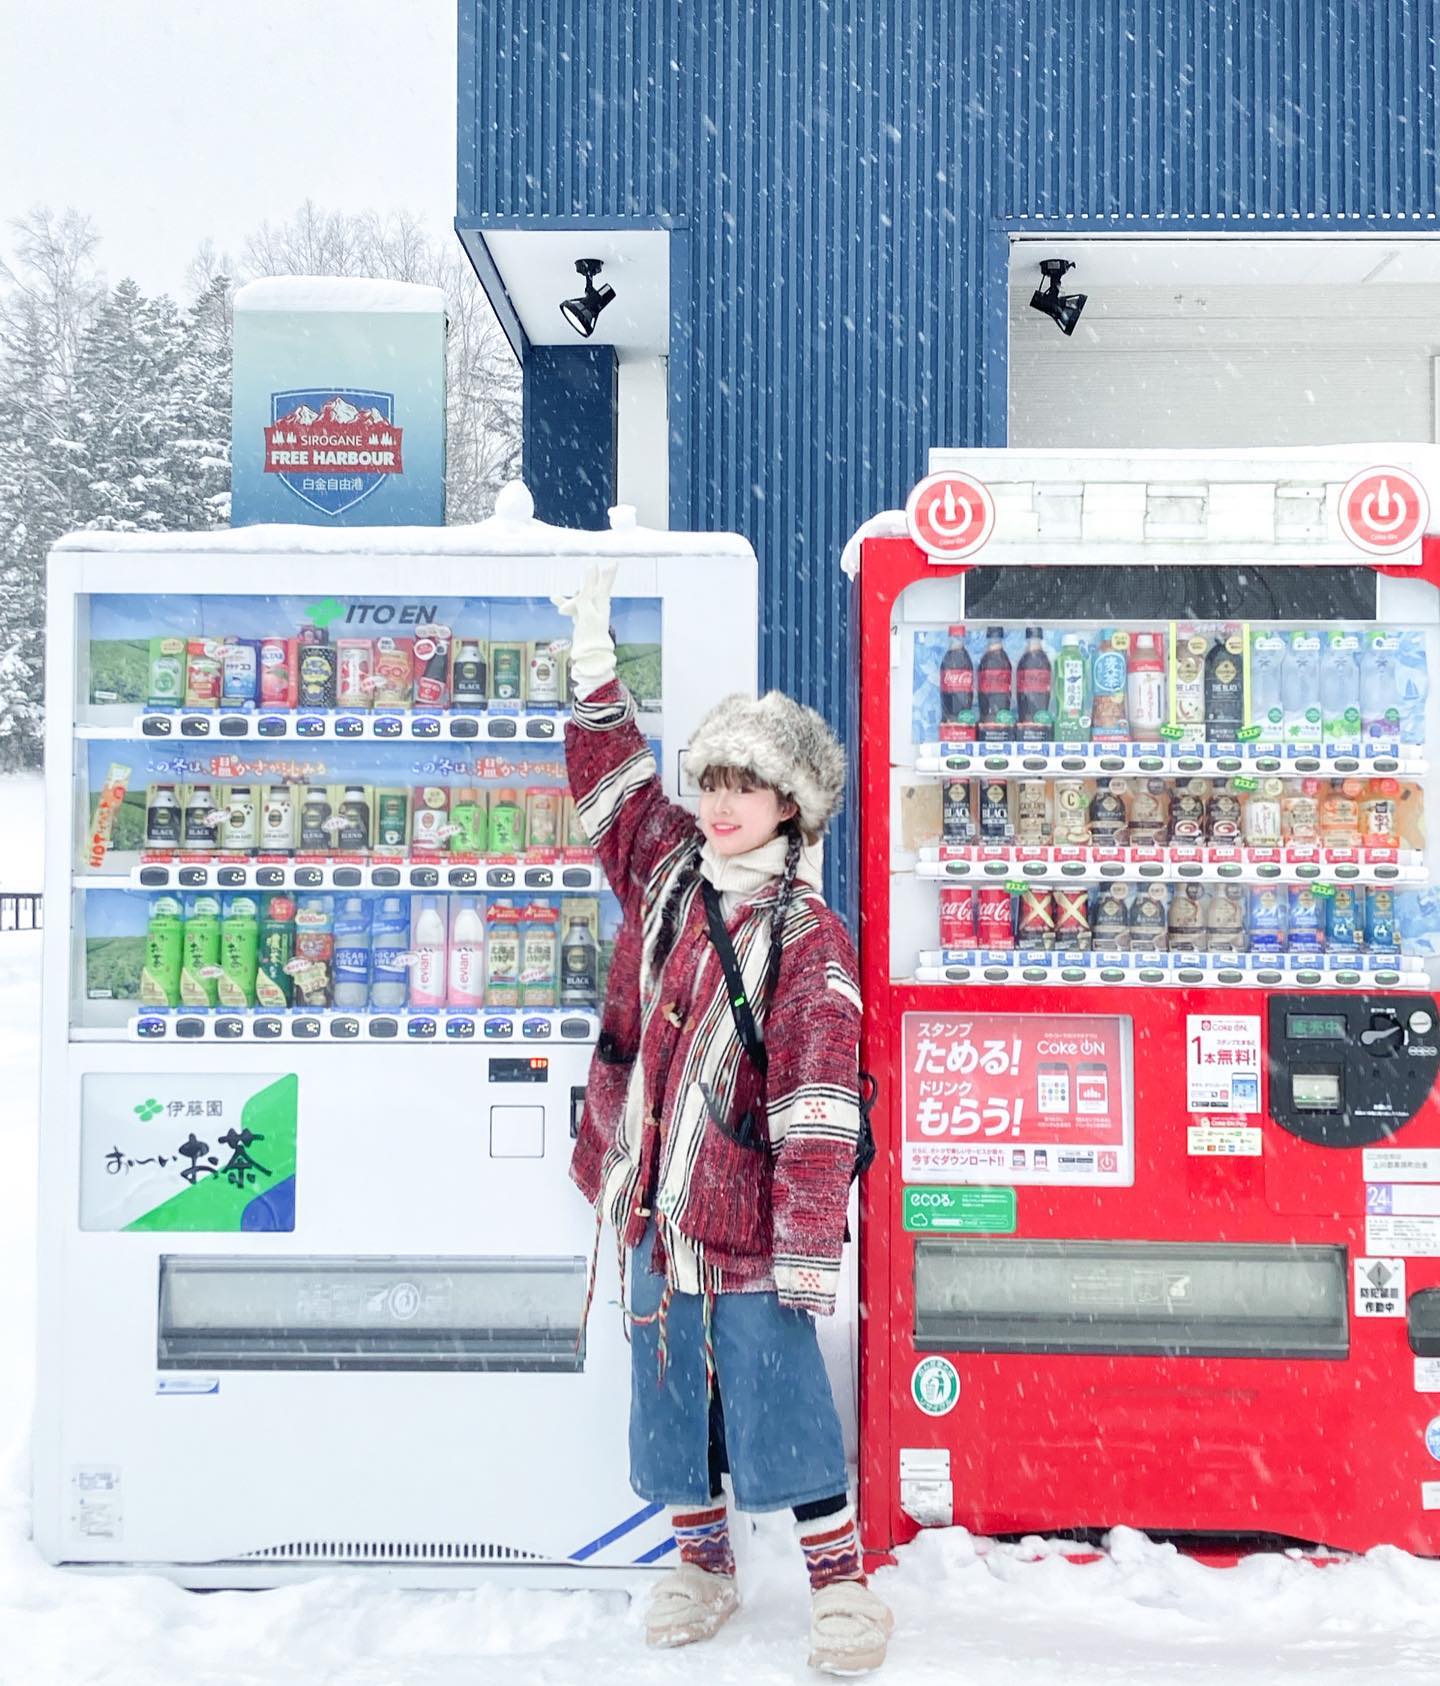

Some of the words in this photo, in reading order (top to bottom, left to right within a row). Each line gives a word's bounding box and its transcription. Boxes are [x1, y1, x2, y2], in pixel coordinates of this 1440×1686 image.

[301, 434, 362, 447] SIROGANE
[271, 451, 308, 465] FREE
[313, 450, 395, 466] HARBOUR
[302, 478, 364, 491] 白金自由港
[345, 605, 395, 625] ITO
[398, 605, 438, 625] EN
[945, 808, 970, 819] BLACK
[982, 808, 1008, 819] BLACK
[420, 953, 430, 984] evian
[459, 953, 469, 984] evian
[566, 977, 590, 985] BLACK
[917, 1022, 974, 1038] スタンプ
[1036, 1040, 1078, 1055] Coke
[1080, 1040, 1106, 1055] ON
[919, 1081, 973, 1097] ドリンク
[166, 1100, 223, 1117] 伊藤園
[1367, 1186, 1389, 1208] 24
